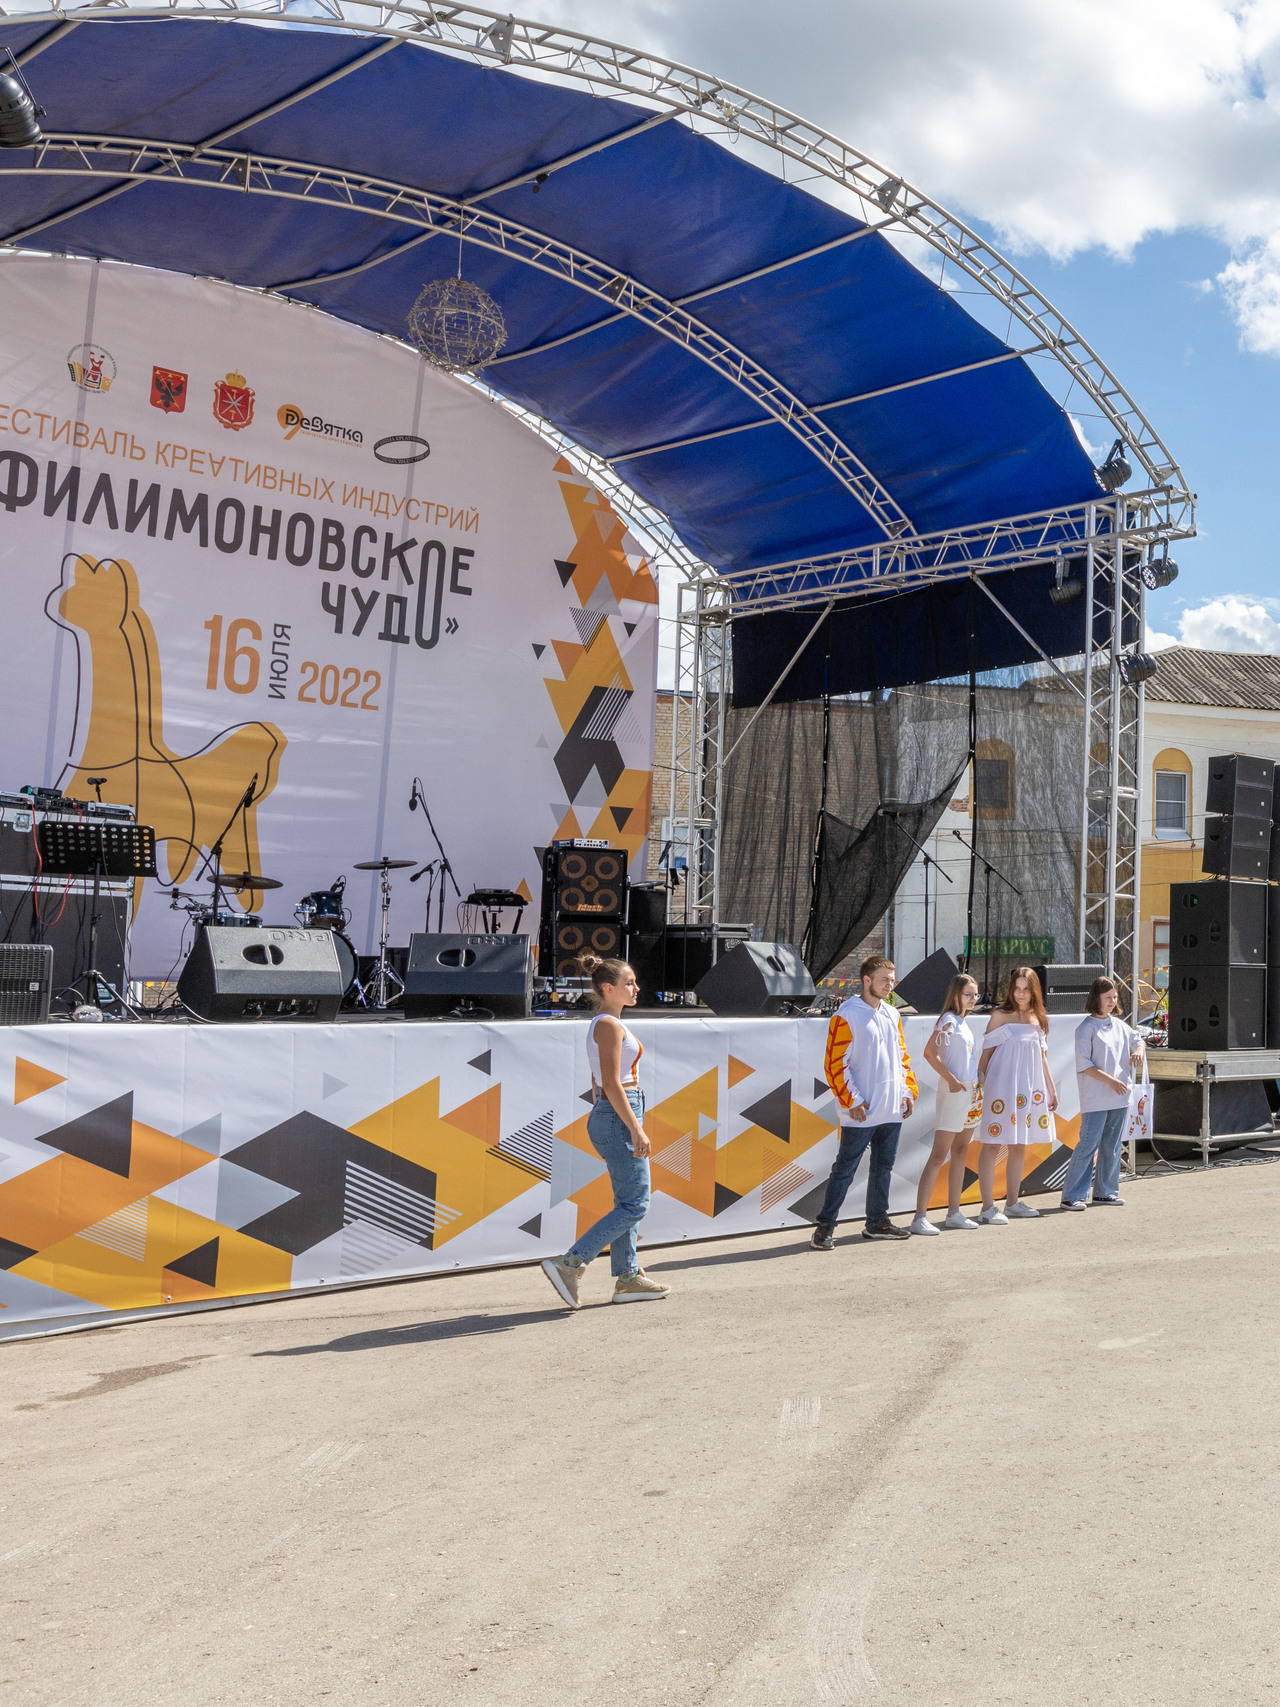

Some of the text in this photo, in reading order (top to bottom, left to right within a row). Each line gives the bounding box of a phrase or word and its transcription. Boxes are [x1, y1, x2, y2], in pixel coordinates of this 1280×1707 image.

[155, 440, 335, 503] КРЕАТИВНЫХ
[342, 483, 480, 534] ИНДУСТРИЙ
[203, 614, 263, 695] 16
[267, 622, 292, 700] ИЮЛЯ
[297, 660, 382, 711] 2022
[970, 938, 1049, 956] НОАРИУС
